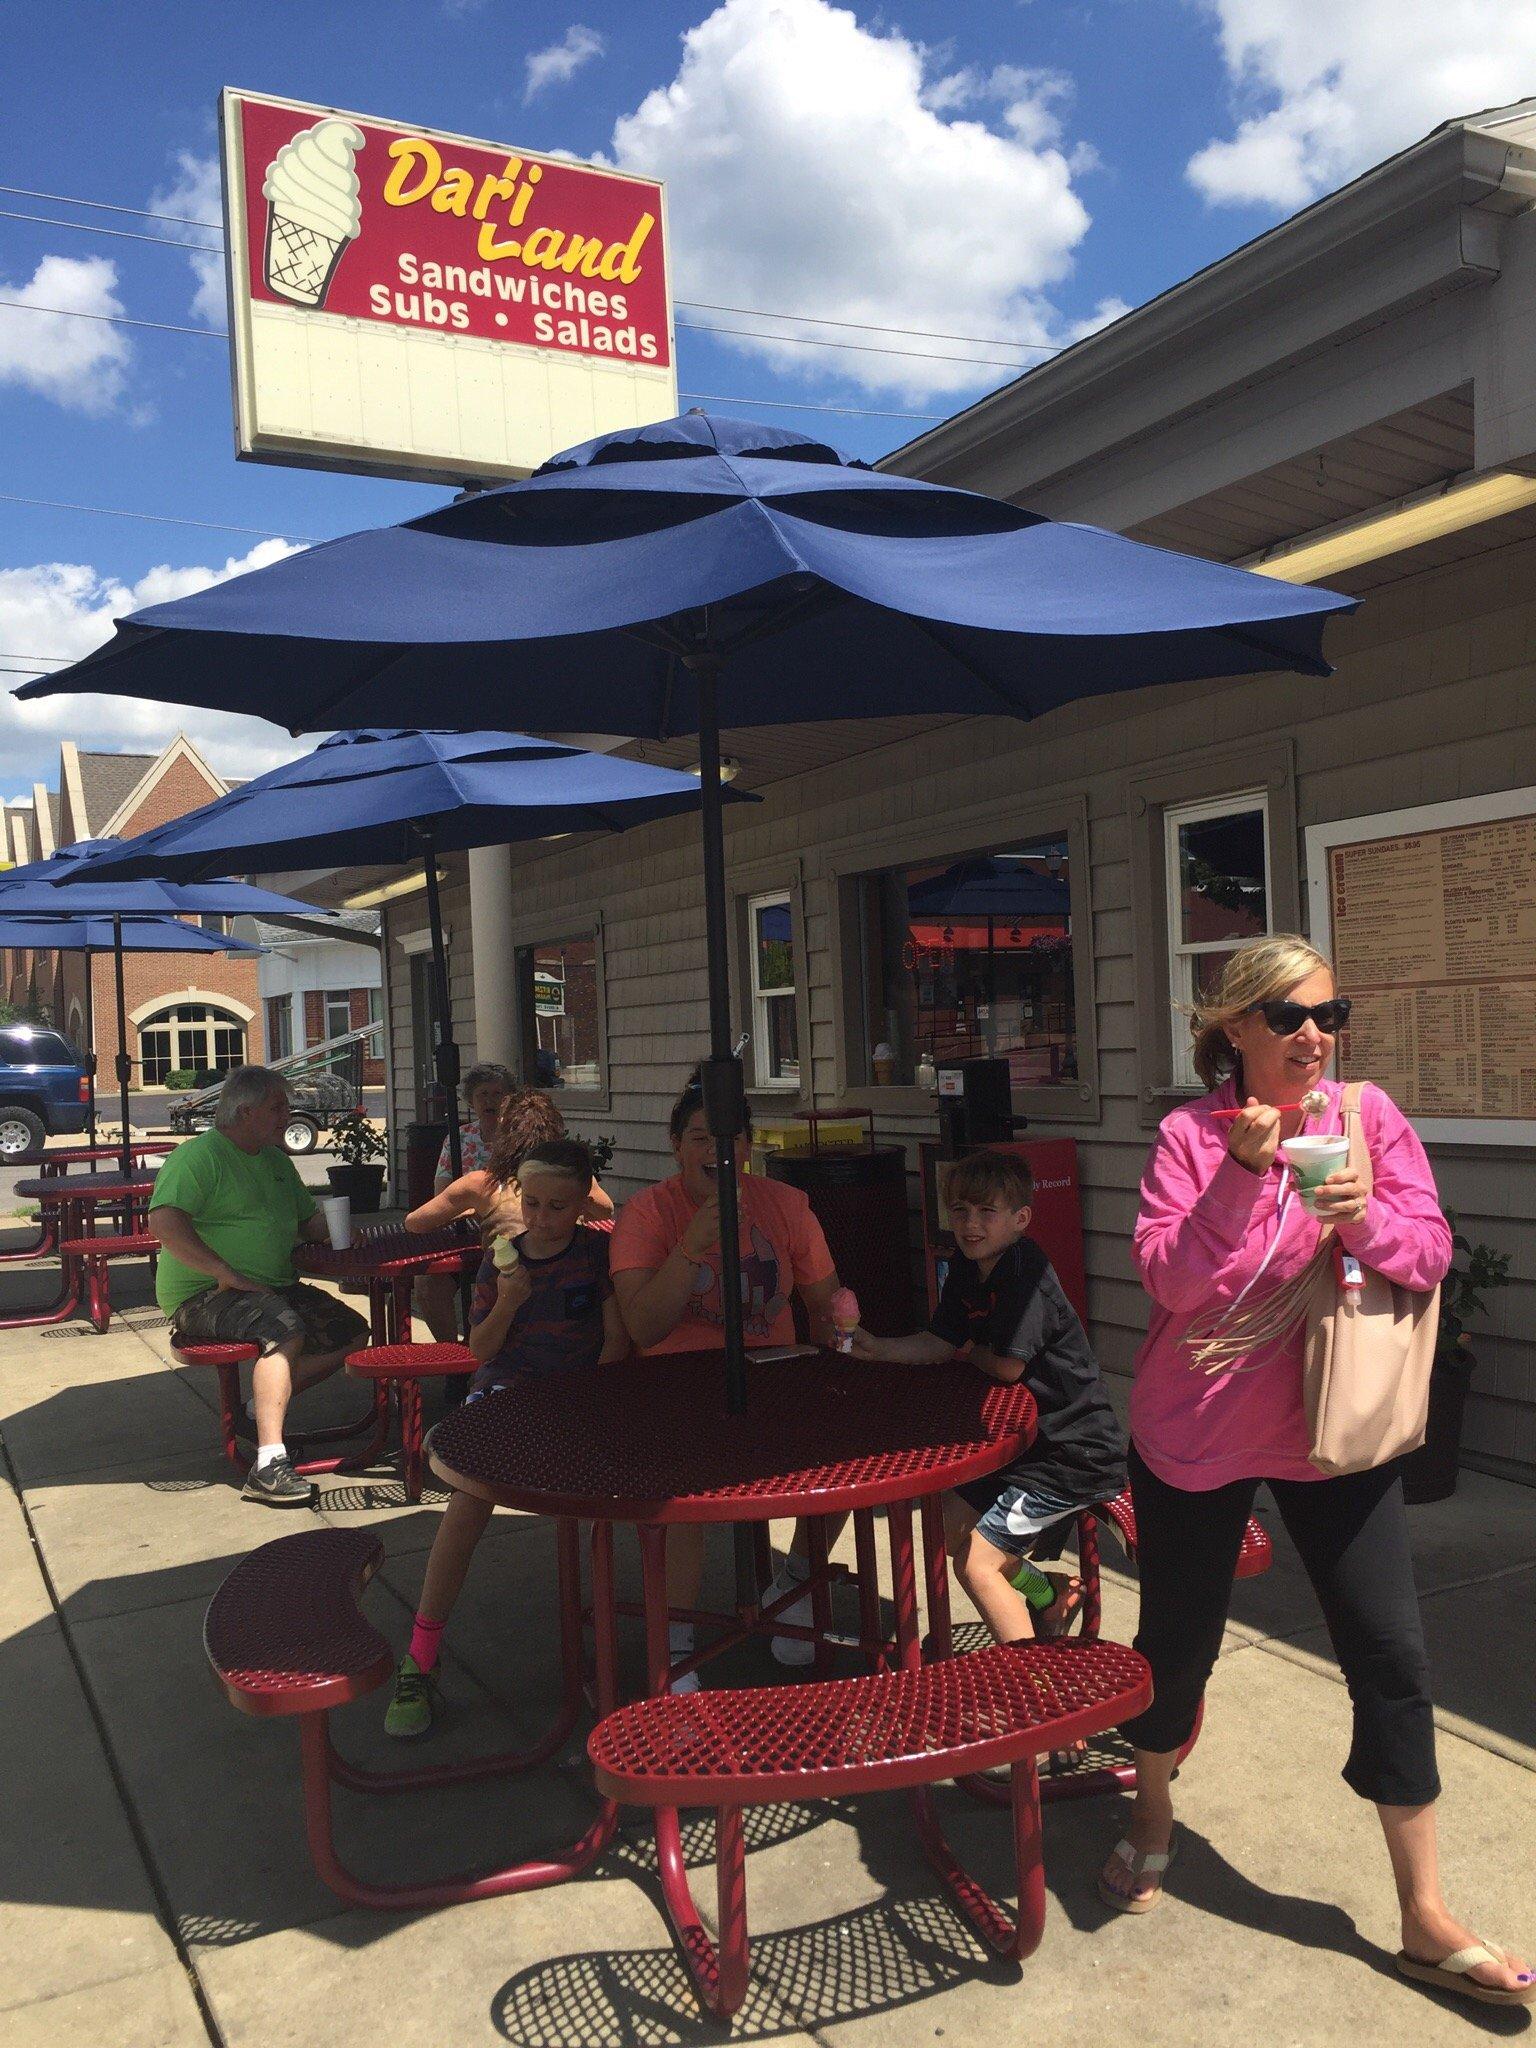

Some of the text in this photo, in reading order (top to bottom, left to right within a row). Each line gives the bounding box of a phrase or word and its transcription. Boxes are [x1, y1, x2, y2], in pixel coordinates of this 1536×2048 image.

[383, 137, 544, 227] Dari
[477, 211, 657, 286] Land
[370, 283, 658, 359] Subs Salads
[398, 252, 627, 320] Sandwiches
[1345, 849, 1366, 858] SUPER
[1368, 844, 1398, 855] SUNDAES
[1041, 1176, 1071, 1189] Record
